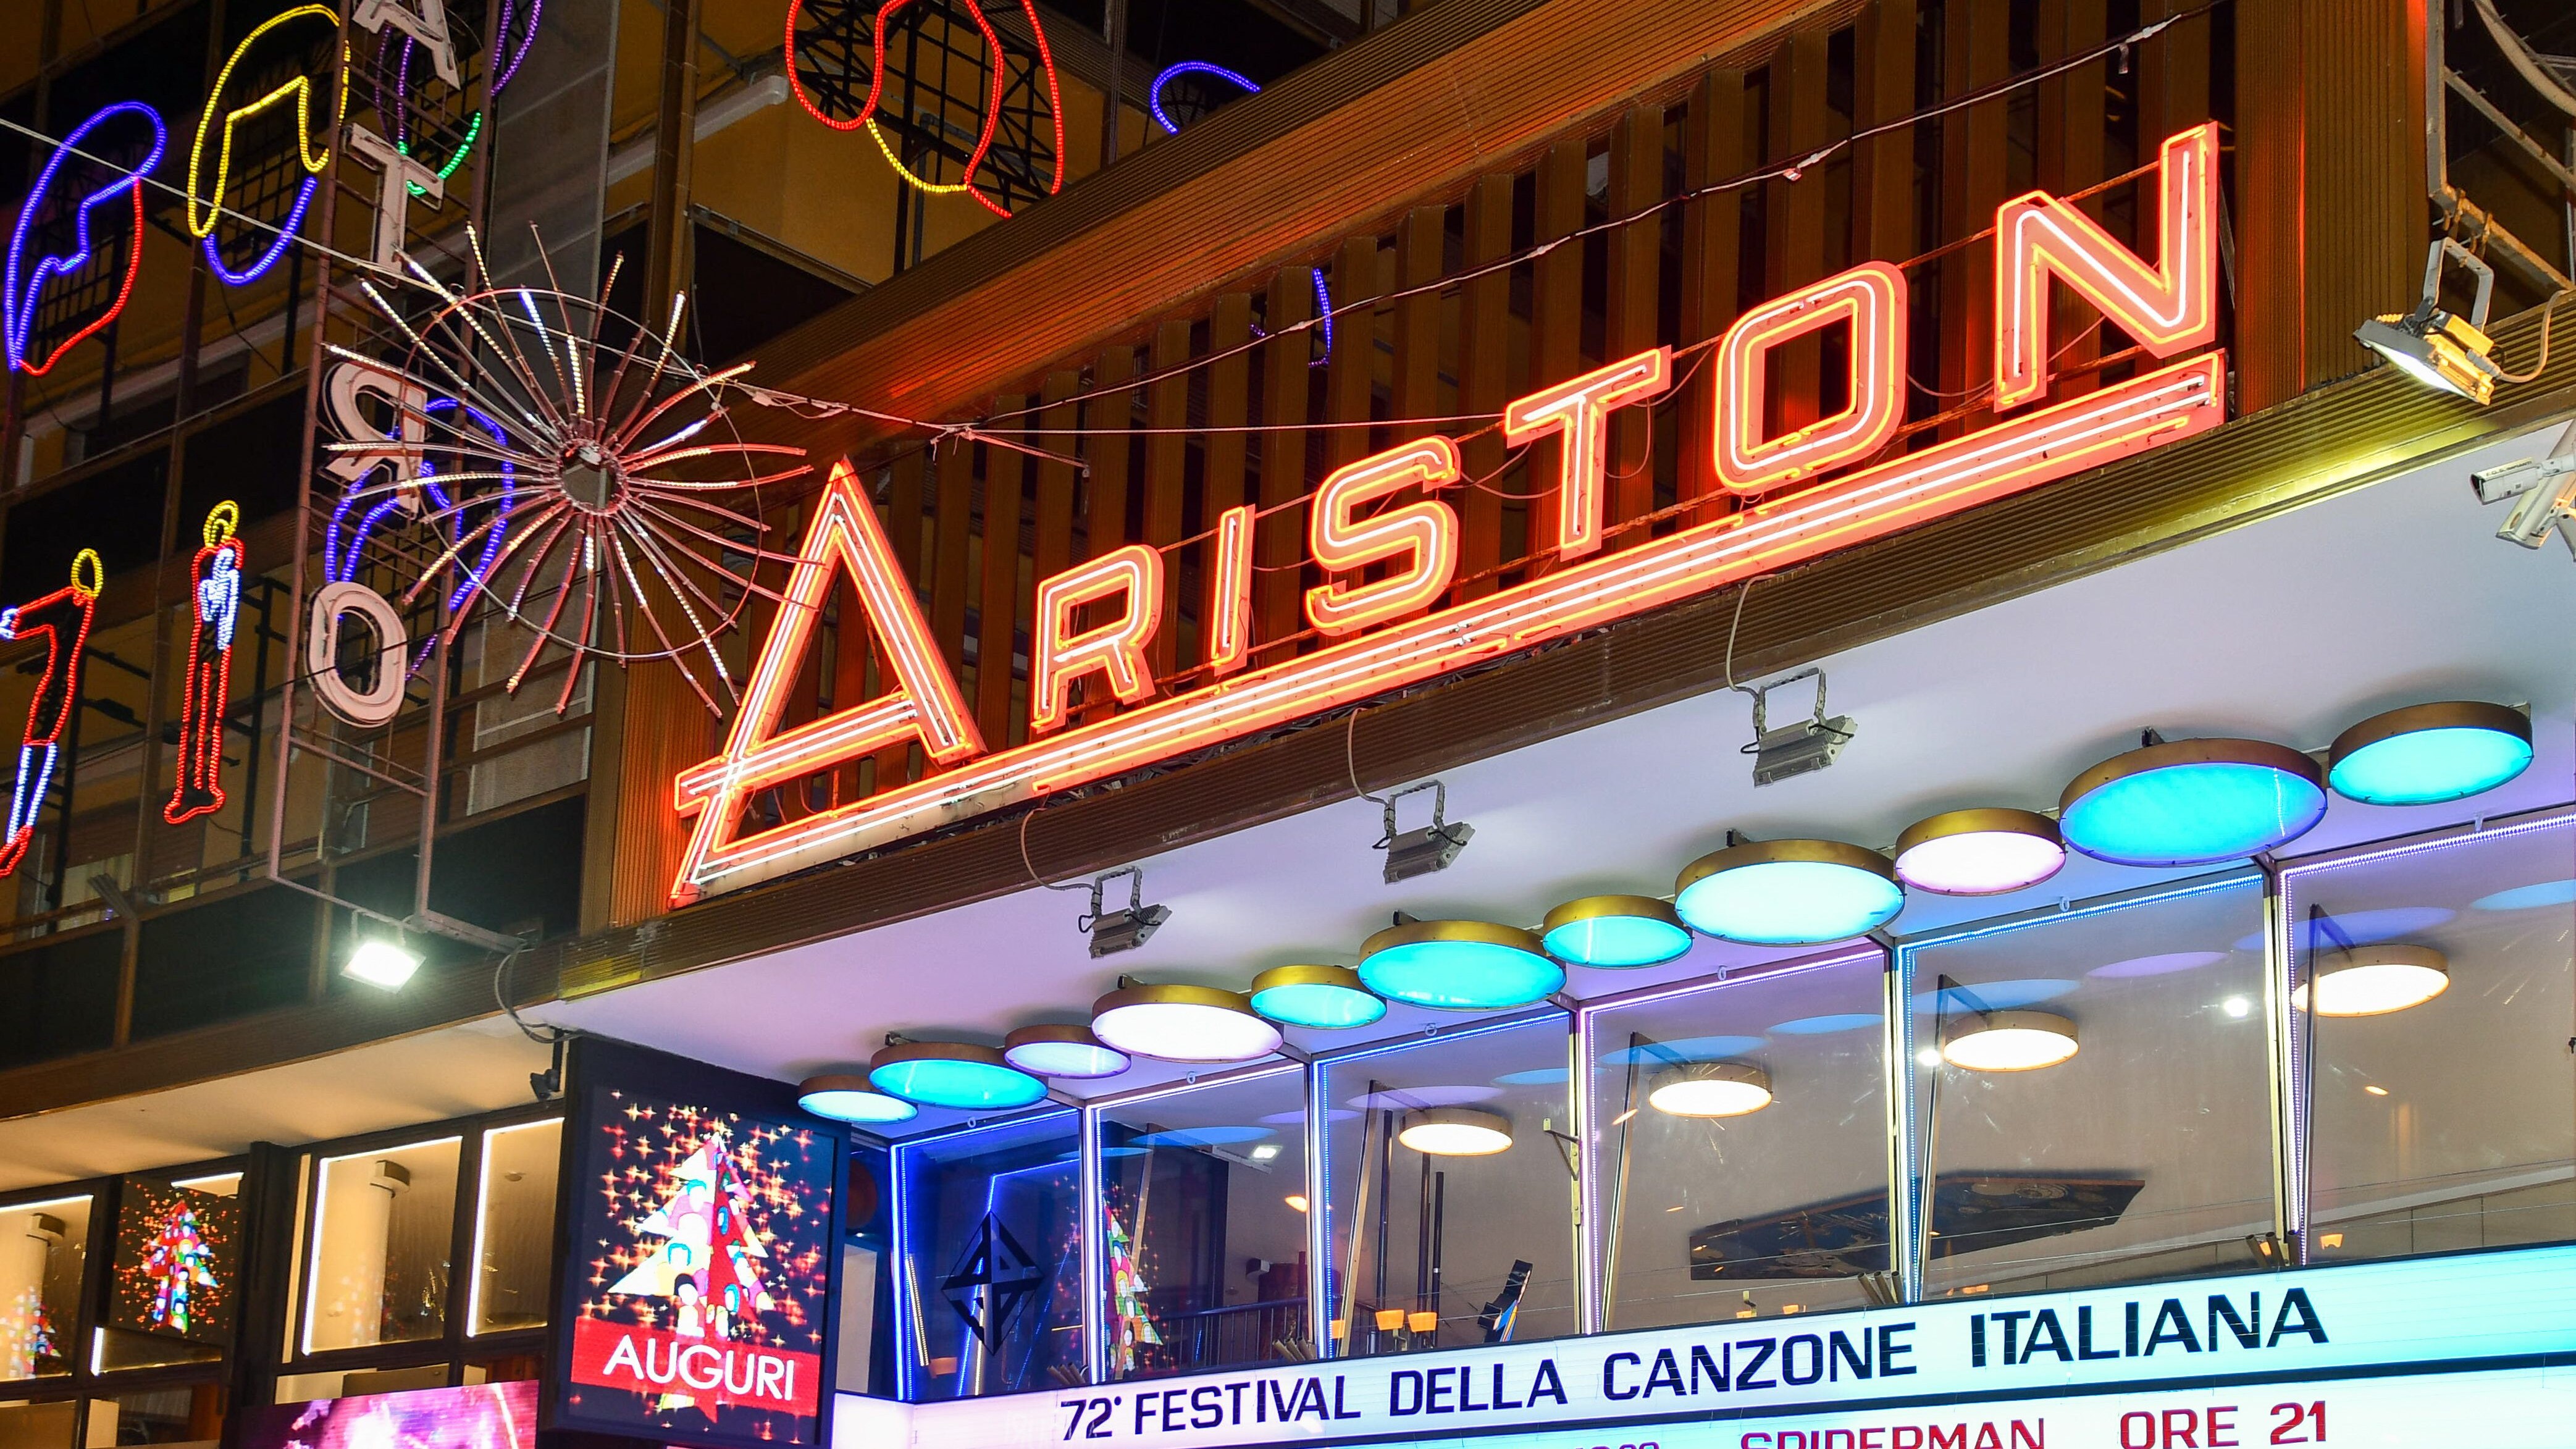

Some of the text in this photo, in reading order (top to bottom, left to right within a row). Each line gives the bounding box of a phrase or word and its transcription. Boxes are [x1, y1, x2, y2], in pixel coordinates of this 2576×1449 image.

[669, 121, 2226, 908] ARISTON
[603, 1334, 794, 1401] AUGURI
[1135, 1375, 1361, 1435] FESTIVAL
[1390, 1358, 1568, 1417] DELLA
[1603, 1322, 1917, 1401] CANZONE
[1971, 1287, 2329, 1367] ITALIANA
[2120, 1406, 2239, 1449] ORE
[2270, 1400, 2326, 1445] 21
